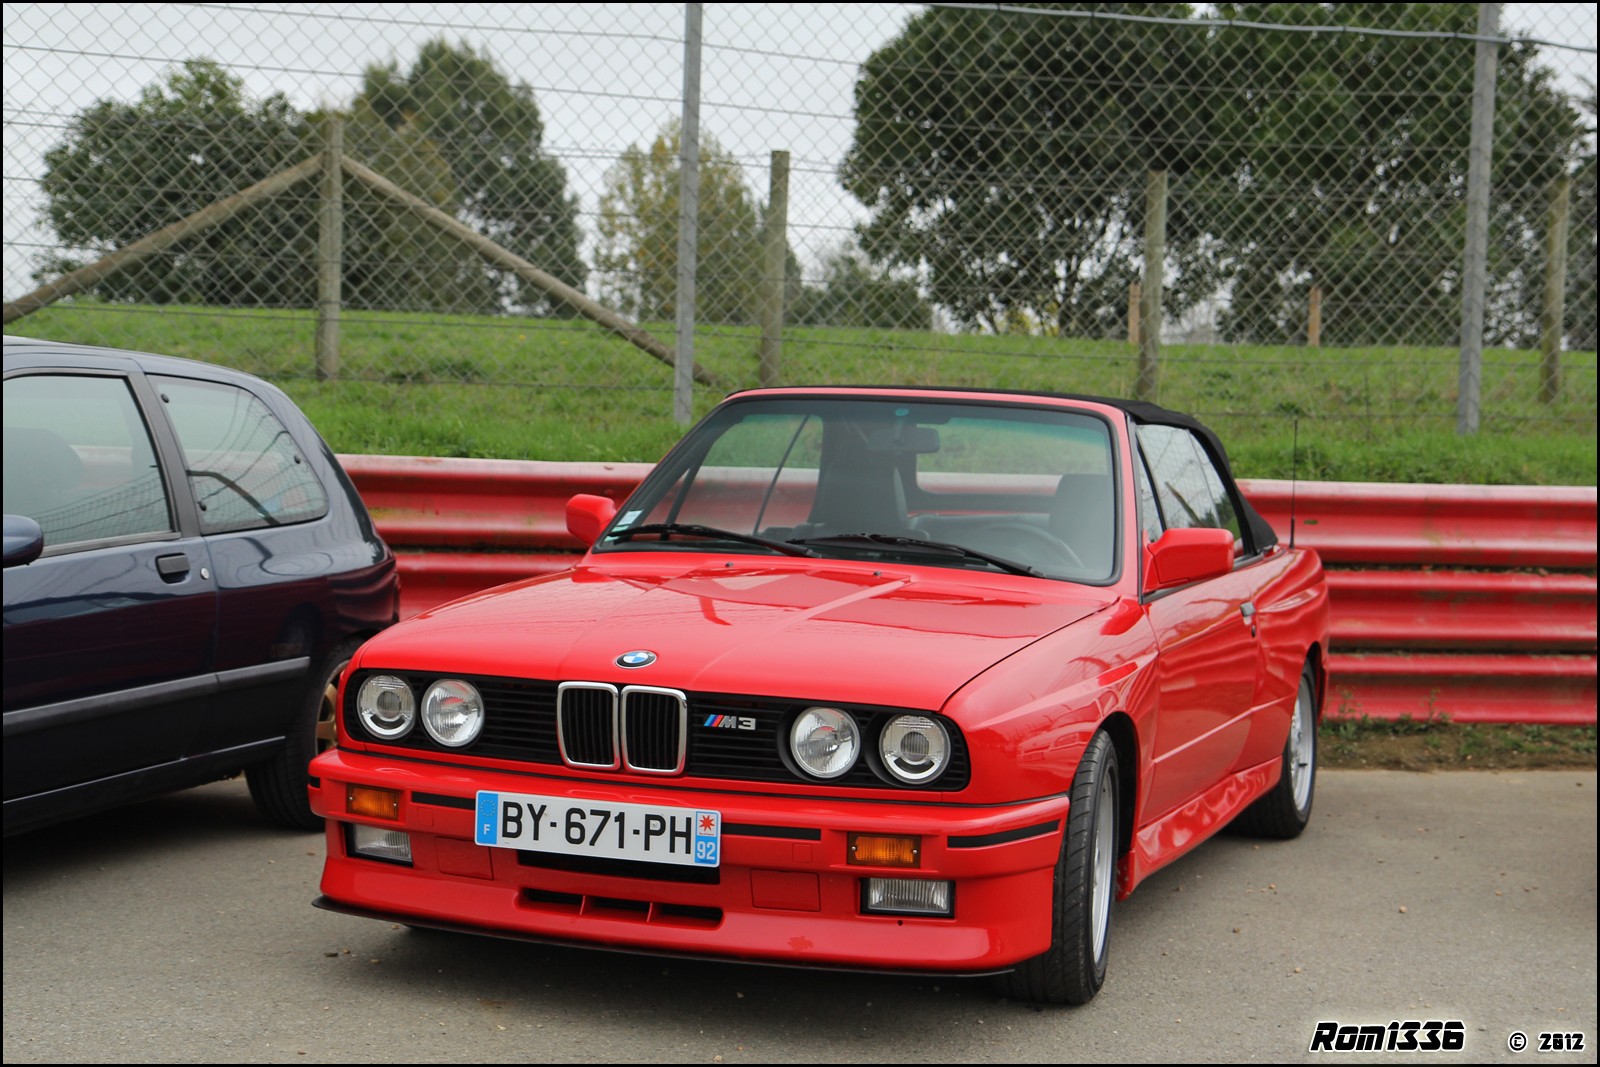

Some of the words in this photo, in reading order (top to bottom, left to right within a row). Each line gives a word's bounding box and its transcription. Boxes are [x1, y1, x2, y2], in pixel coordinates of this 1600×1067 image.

[718, 715, 756, 730] M3
[483, 823, 491, 836] F
[502, 801, 692, 854] BY-671-PH
[697, 841, 716, 860] 92
